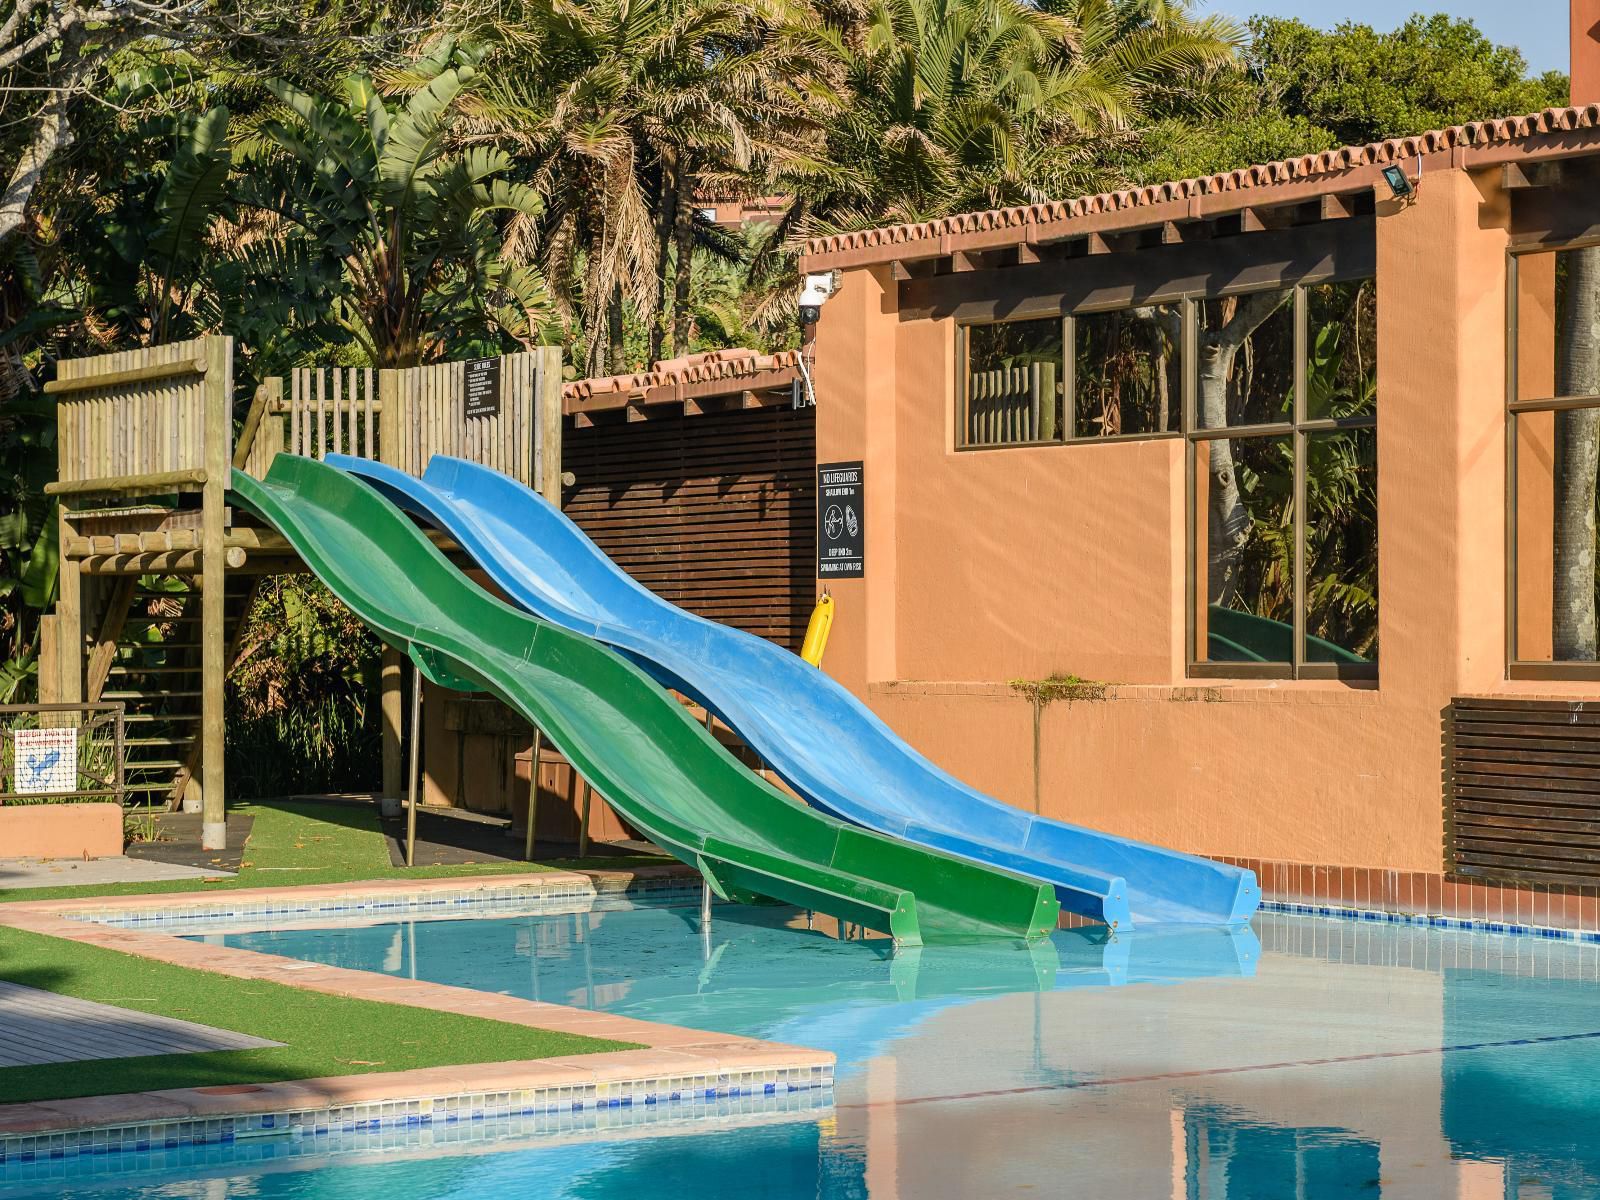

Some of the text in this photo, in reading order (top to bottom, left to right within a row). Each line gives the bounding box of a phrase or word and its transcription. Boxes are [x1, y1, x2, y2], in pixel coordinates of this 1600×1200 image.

[823, 471, 858, 483] NO LIFEGUARDS
[820, 563, 839, 572] SWIMMING
[852, 562, 862, 571] RISK
